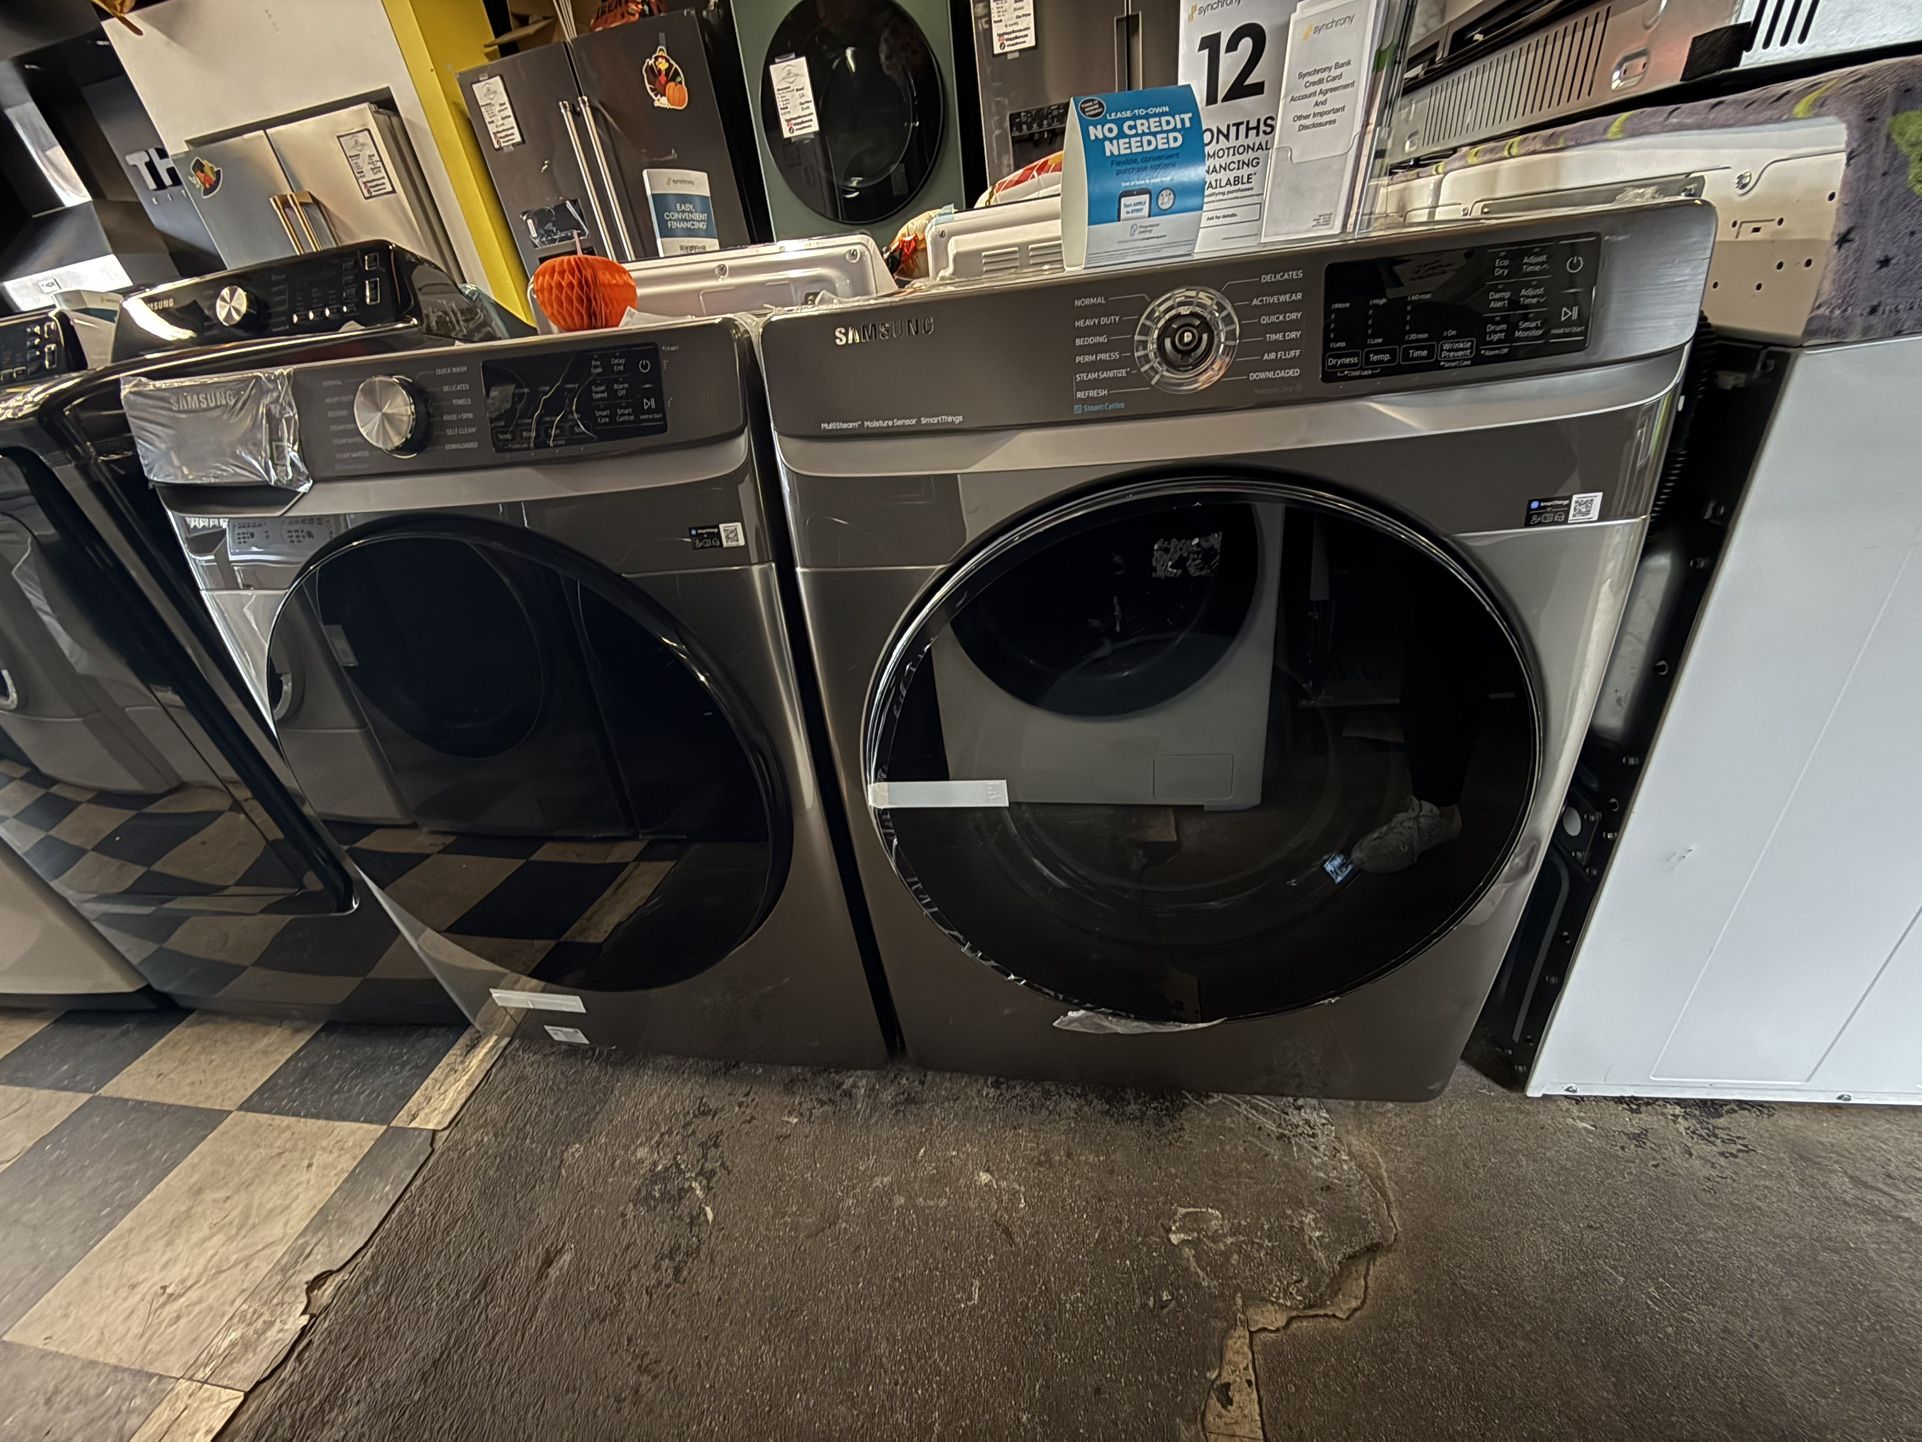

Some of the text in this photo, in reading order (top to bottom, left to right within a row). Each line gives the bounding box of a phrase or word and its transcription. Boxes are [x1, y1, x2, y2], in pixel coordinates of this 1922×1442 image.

[1313, 14, 1355, 34] synchrony
[1197, 22, 1267, 107] 12
[1297, 59, 1352, 80] Synchrony Bank
[1304, 71, 1343, 89] Credit Card
[1289, 80, 1355, 104] Account Agreement
[1313, 98, 1327, 108] And
[1292, 105, 1346, 123] Other Important
[1088, 113, 1192, 140] NO CREDIT
[1203, 115, 1276, 147] ONTHS
[1297, 119, 1337, 132] Disclosures
[1207, 140, 1272, 161] MOTIONAL
[125, 147, 174, 191] TH
[1205, 156, 1260, 176] ANCING
[664, 211, 708, 221] CONVENIENT
[1495, 258, 1510, 267] Eco
[1522, 254, 1548, 265] Adjust
[1494, 267, 1508, 277] Dry
[1522, 264, 1541, 274] Time
[1261, 270, 1304, 283] DELICATES
[1489, 291, 1511, 301] Damp
[1520, 287, 1545, 298] Adjust
[1075, 295, 1106, 307] NORMAL
[1252, 292, 1302, 306] ACTIVEWEAR
[1489, 299, 1509, 309] Alert
[1520, 297, 1538, 306] Time
[1075, 315, 1120, 328] HEAVY DUTY
[1260, 311, 1302, 325] QUICK DRY
[1519, 319, 1542, 329] Smart
[834, 316, 934, 345] SAMSUNG
[1486, 323, 1508, 332] Drum
[1514, 327, 1544, 338] Monitor
[1075, 334, 1108, 346] BEDDING
[1266, 330, 1301, 342] TIME DRY
[1486, 331, 1506, 342] Light
[1442, 339, 1472, 350] Wrinkle
[1076, 351, 1120, 364] PERM PRESS
[1263, 349, 1301, 361] AIR FLUFF
[1368, 353, 1392, 363] Temp.
[1408, 348, 1429, 358] Time
[1441, 348, 1472, 359] Prevent
[1327, 355, 1359, 367] Dryness
[1076, 371, 1098, 382] STEAM
[1249, 368, 1300, 380] DOWNLOADED
[442, 383, 469, 392] DELICATES
[1076, 388, 1108, 400] REFRESH
[171, 391, 236, 411] SAMSUNG
[1083, 401, 1126, 413] Steam Cycles
[864, 420, 893, 429] Moisture
[893, 418, 918, 427] Sensor
[920, 415, 963, 425] SmartThings
